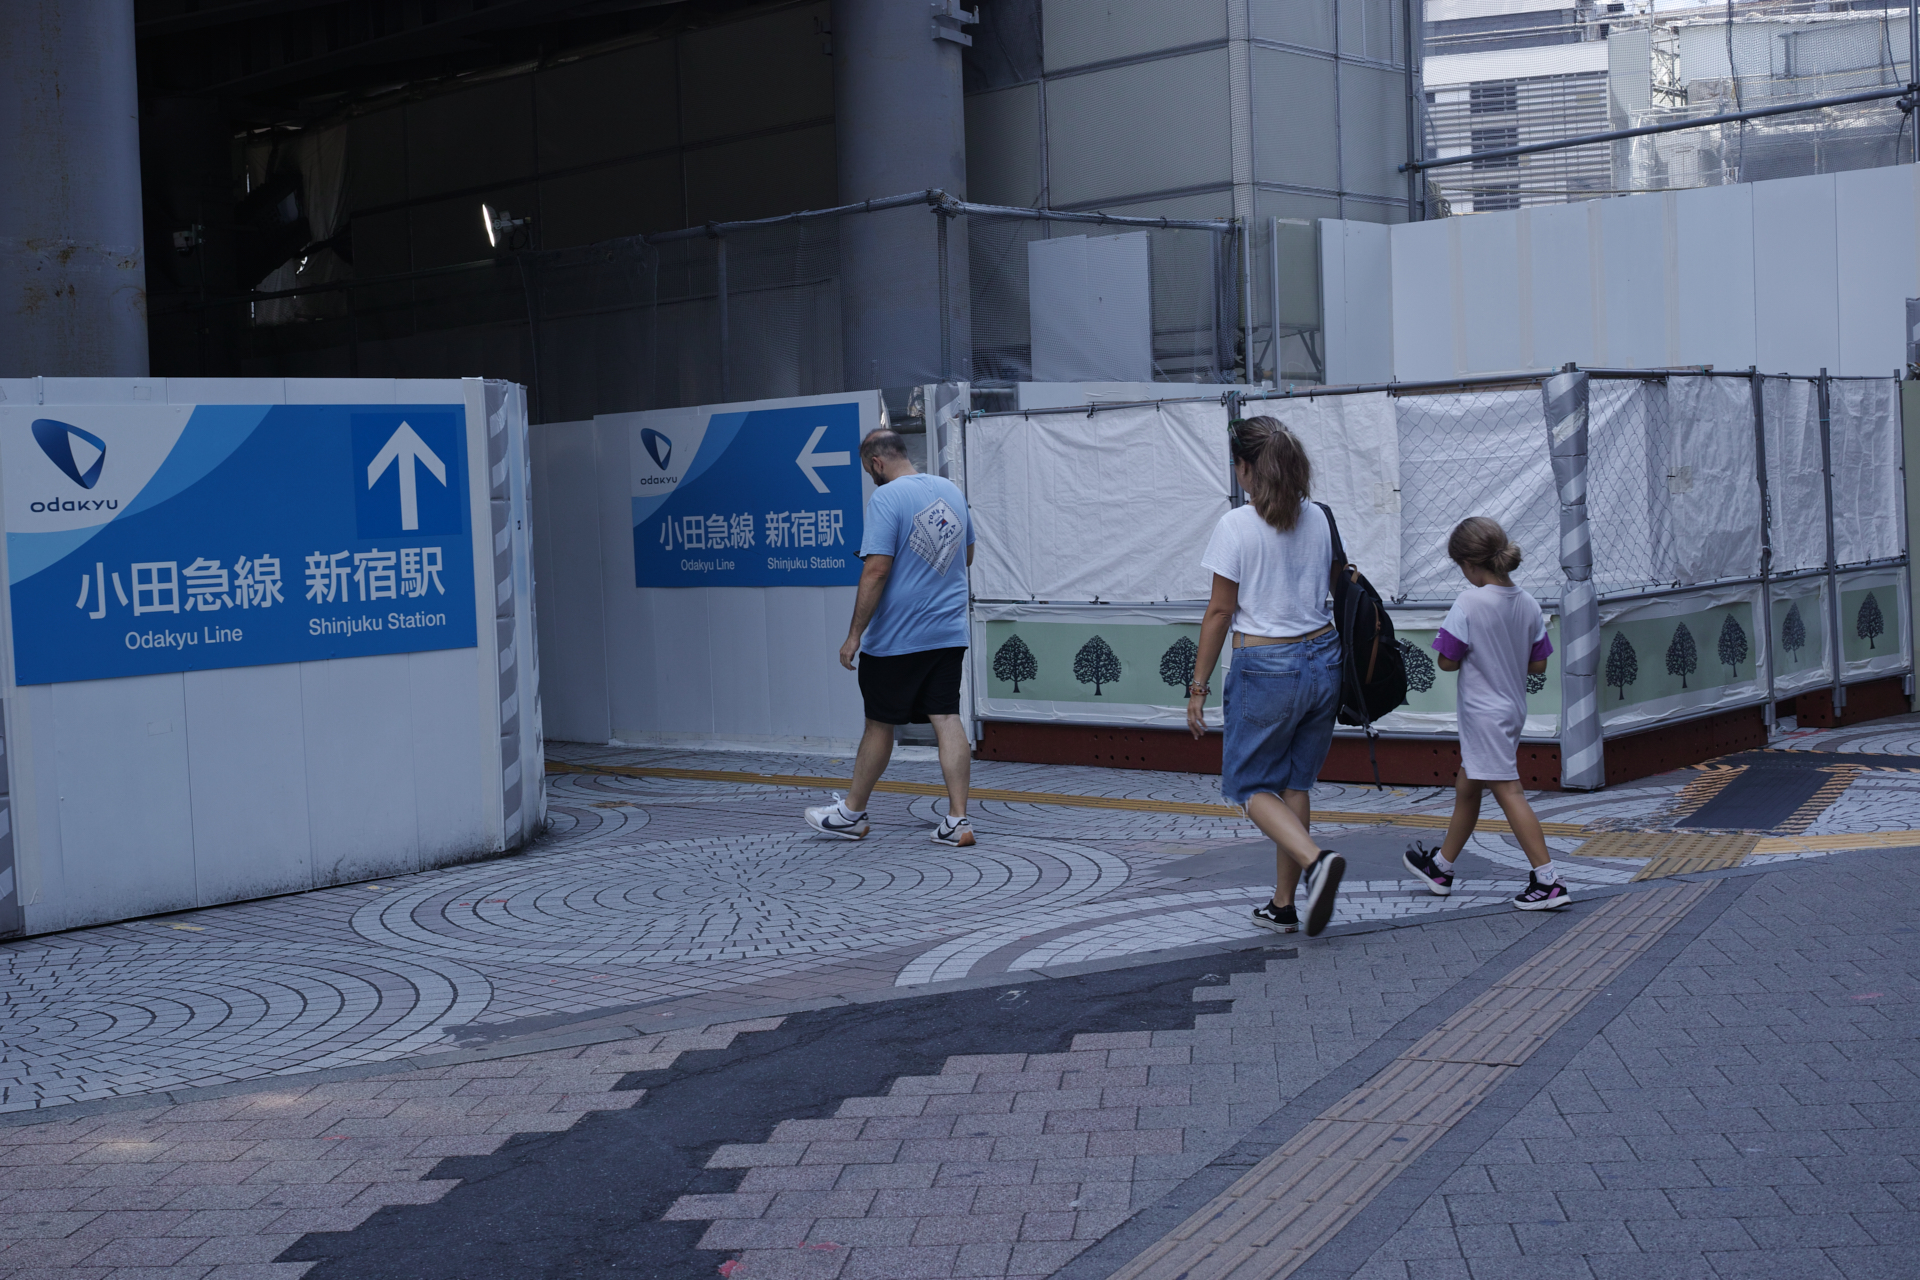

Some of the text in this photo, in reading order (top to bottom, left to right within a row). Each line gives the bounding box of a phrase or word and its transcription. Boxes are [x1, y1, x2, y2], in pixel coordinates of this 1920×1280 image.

[660, 509, 845, 551] 小田急線 新宿駅
[76, 546, 446, 620] 小田急線 新宿駅
[681, 556, 845, 572] Odakyu Line Shinjuku Station
[124, 610, 446, 651] Odakyu Line Shinjuku Station
